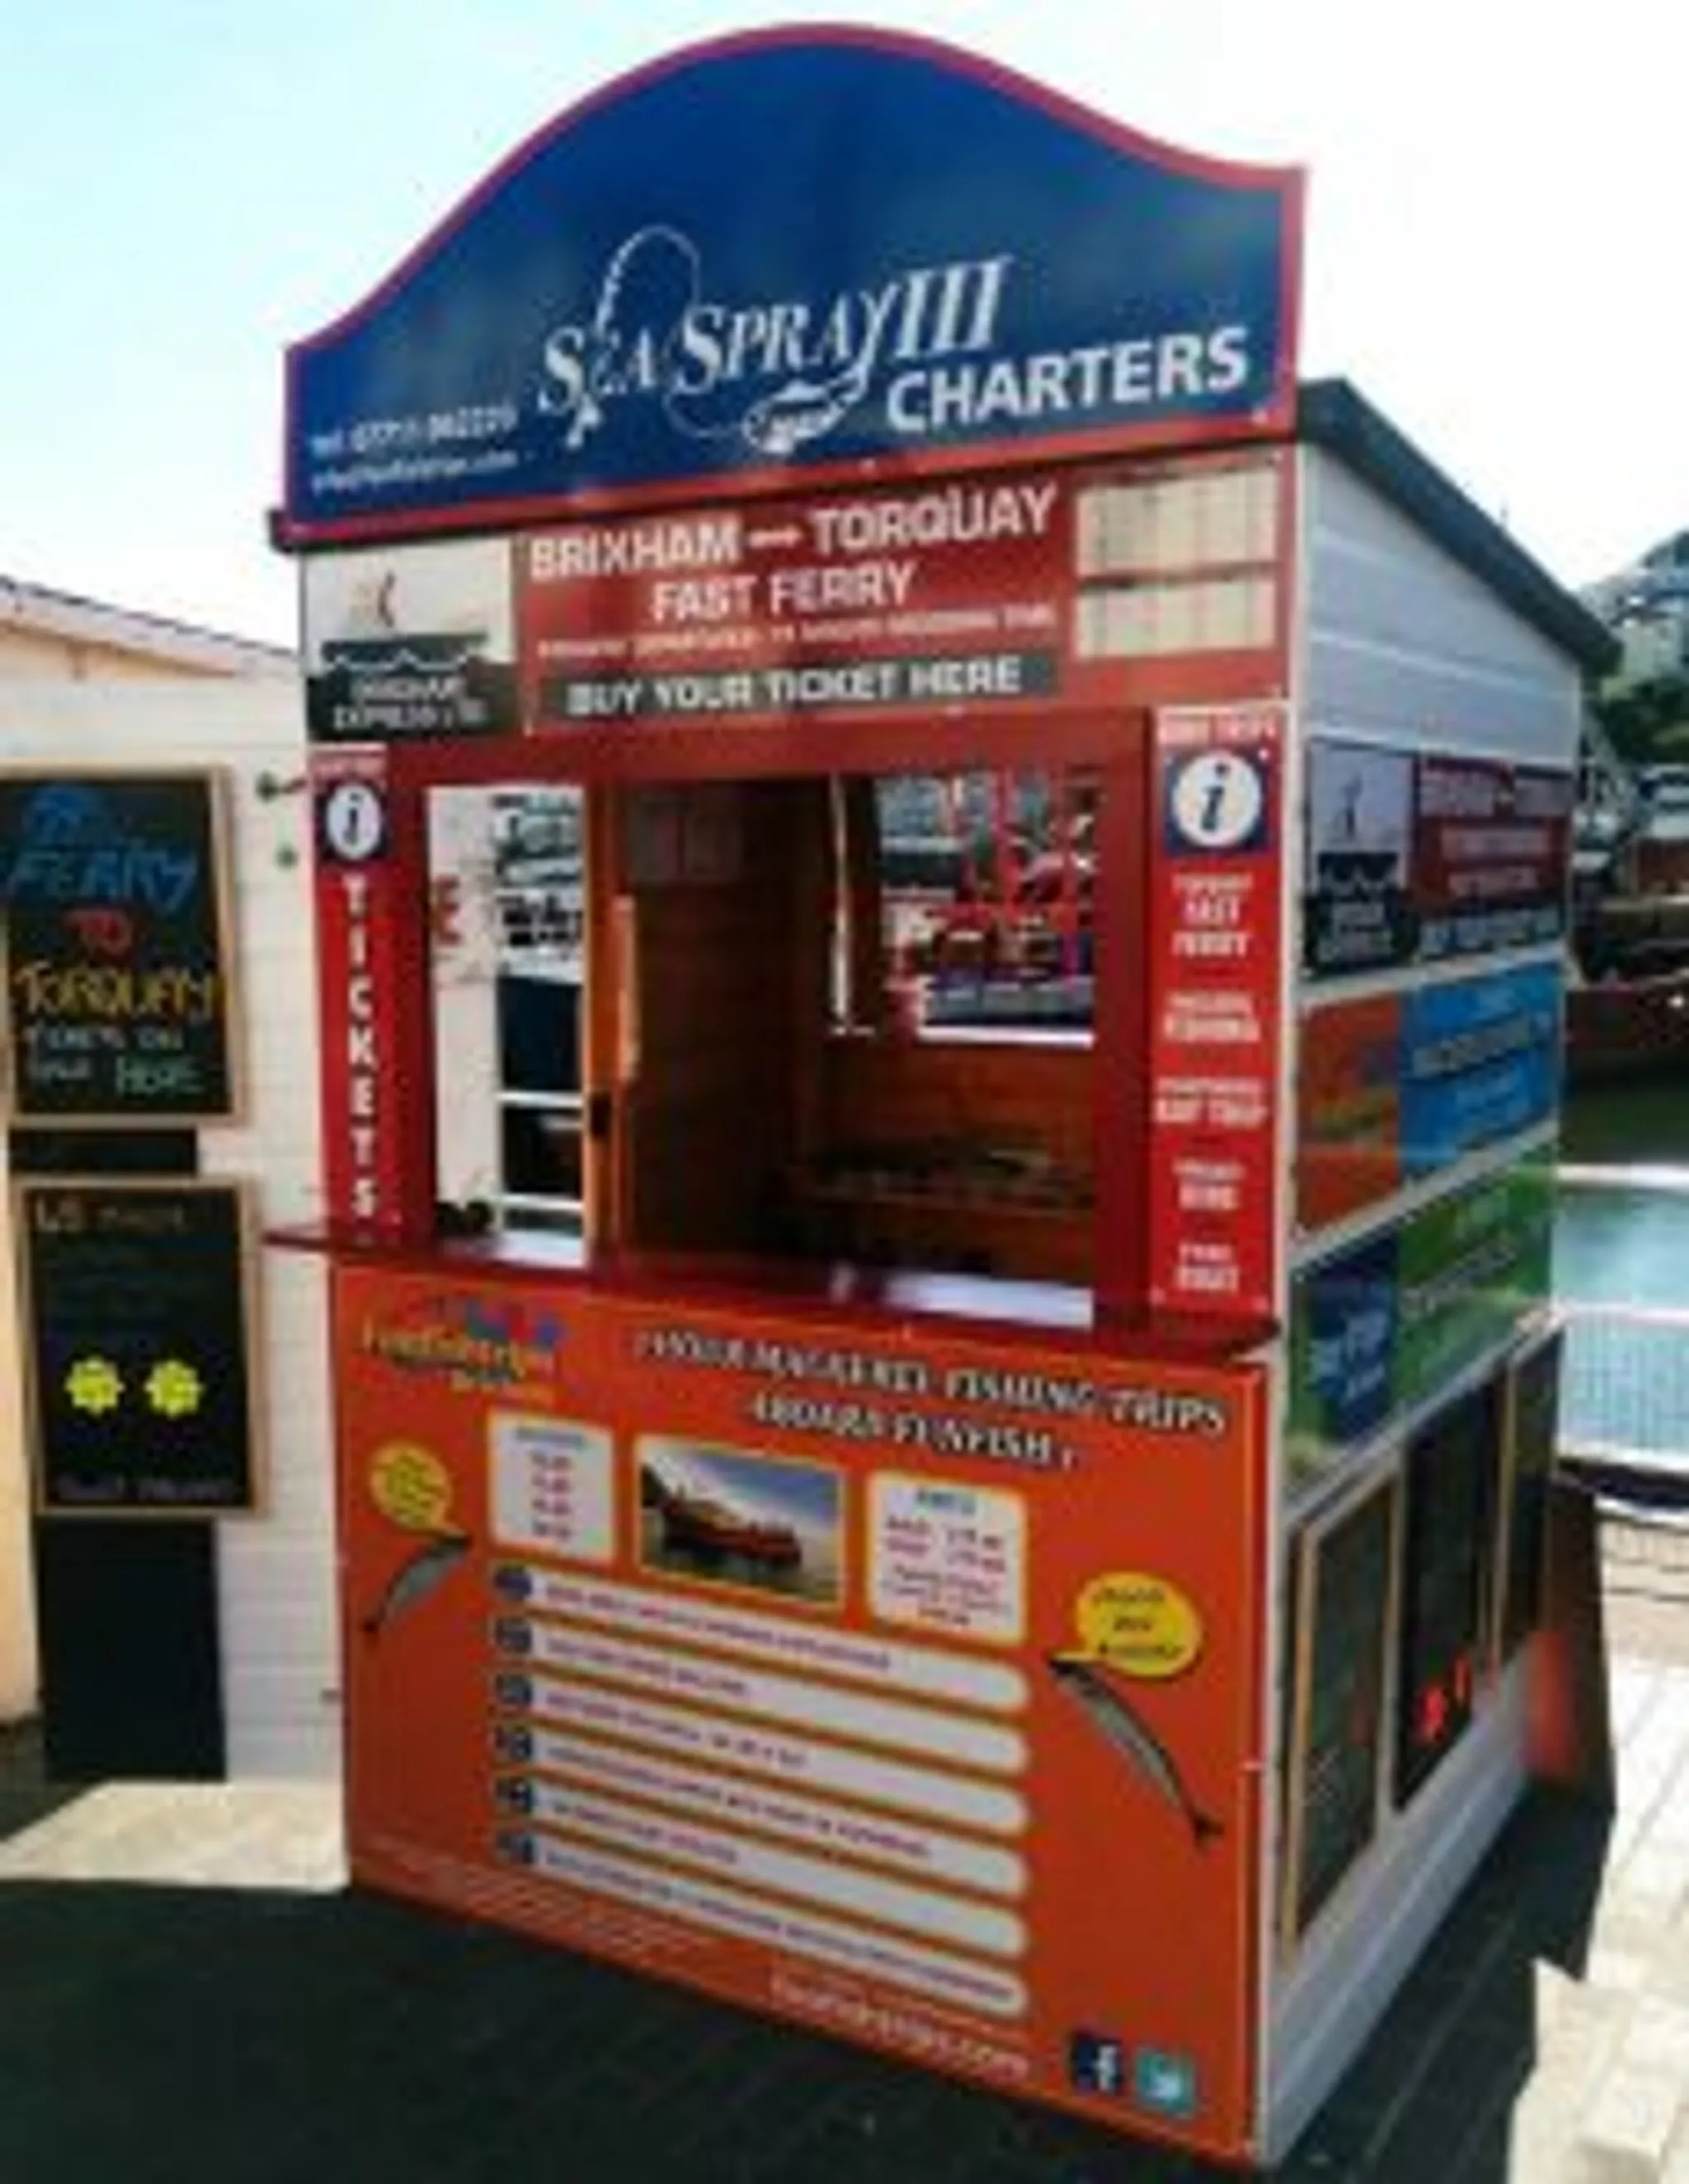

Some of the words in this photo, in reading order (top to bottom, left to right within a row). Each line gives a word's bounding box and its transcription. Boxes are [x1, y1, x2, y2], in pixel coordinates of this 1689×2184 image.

[885, 327, 1249, 435] CHARTERS
[529, 513, 741, 578] BRIXHAM
[809, 483, 1059, 555] TORQUAY
[651, 575, 757, 622] FAST
[769, 560, 920, 615] FERRY
[567, 680, 642, 716] BUY
[654, 672, 753, 711] YOUR
[764, 661, 899, 704] TICKET
[908, 654, 1023, 696] HERE
[341, 870, 378, 1217] TICKETS
[1107, 1387, 1227, 1437] TRIPS
